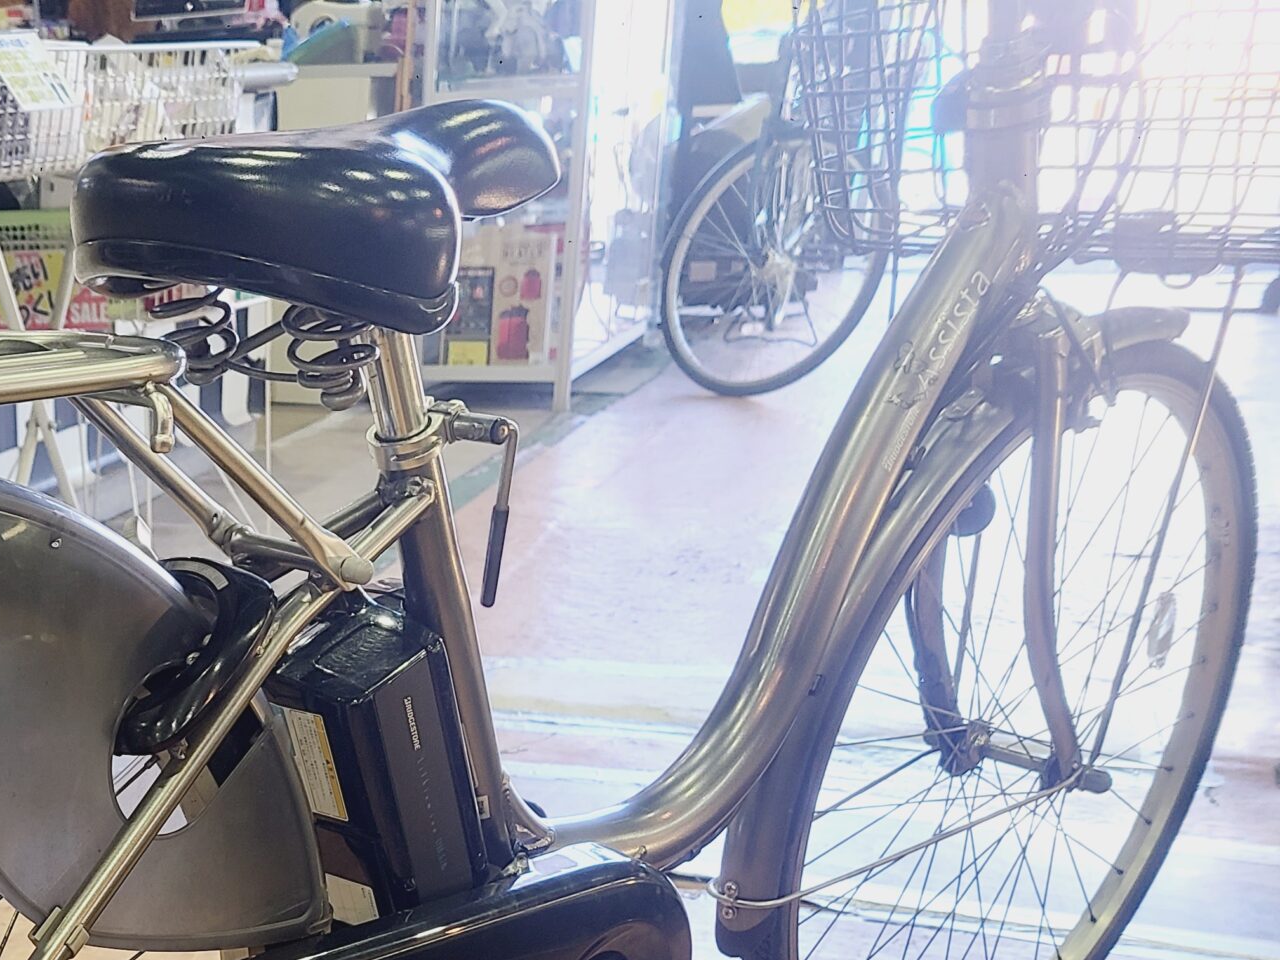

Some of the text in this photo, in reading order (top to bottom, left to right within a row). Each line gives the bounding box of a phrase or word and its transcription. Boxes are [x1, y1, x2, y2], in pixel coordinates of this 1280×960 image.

[70, 302, 109, 324] SALE
[919, 270, 990, 398] Assista
[404, 696, 420, 750] BRIDGESTONE
